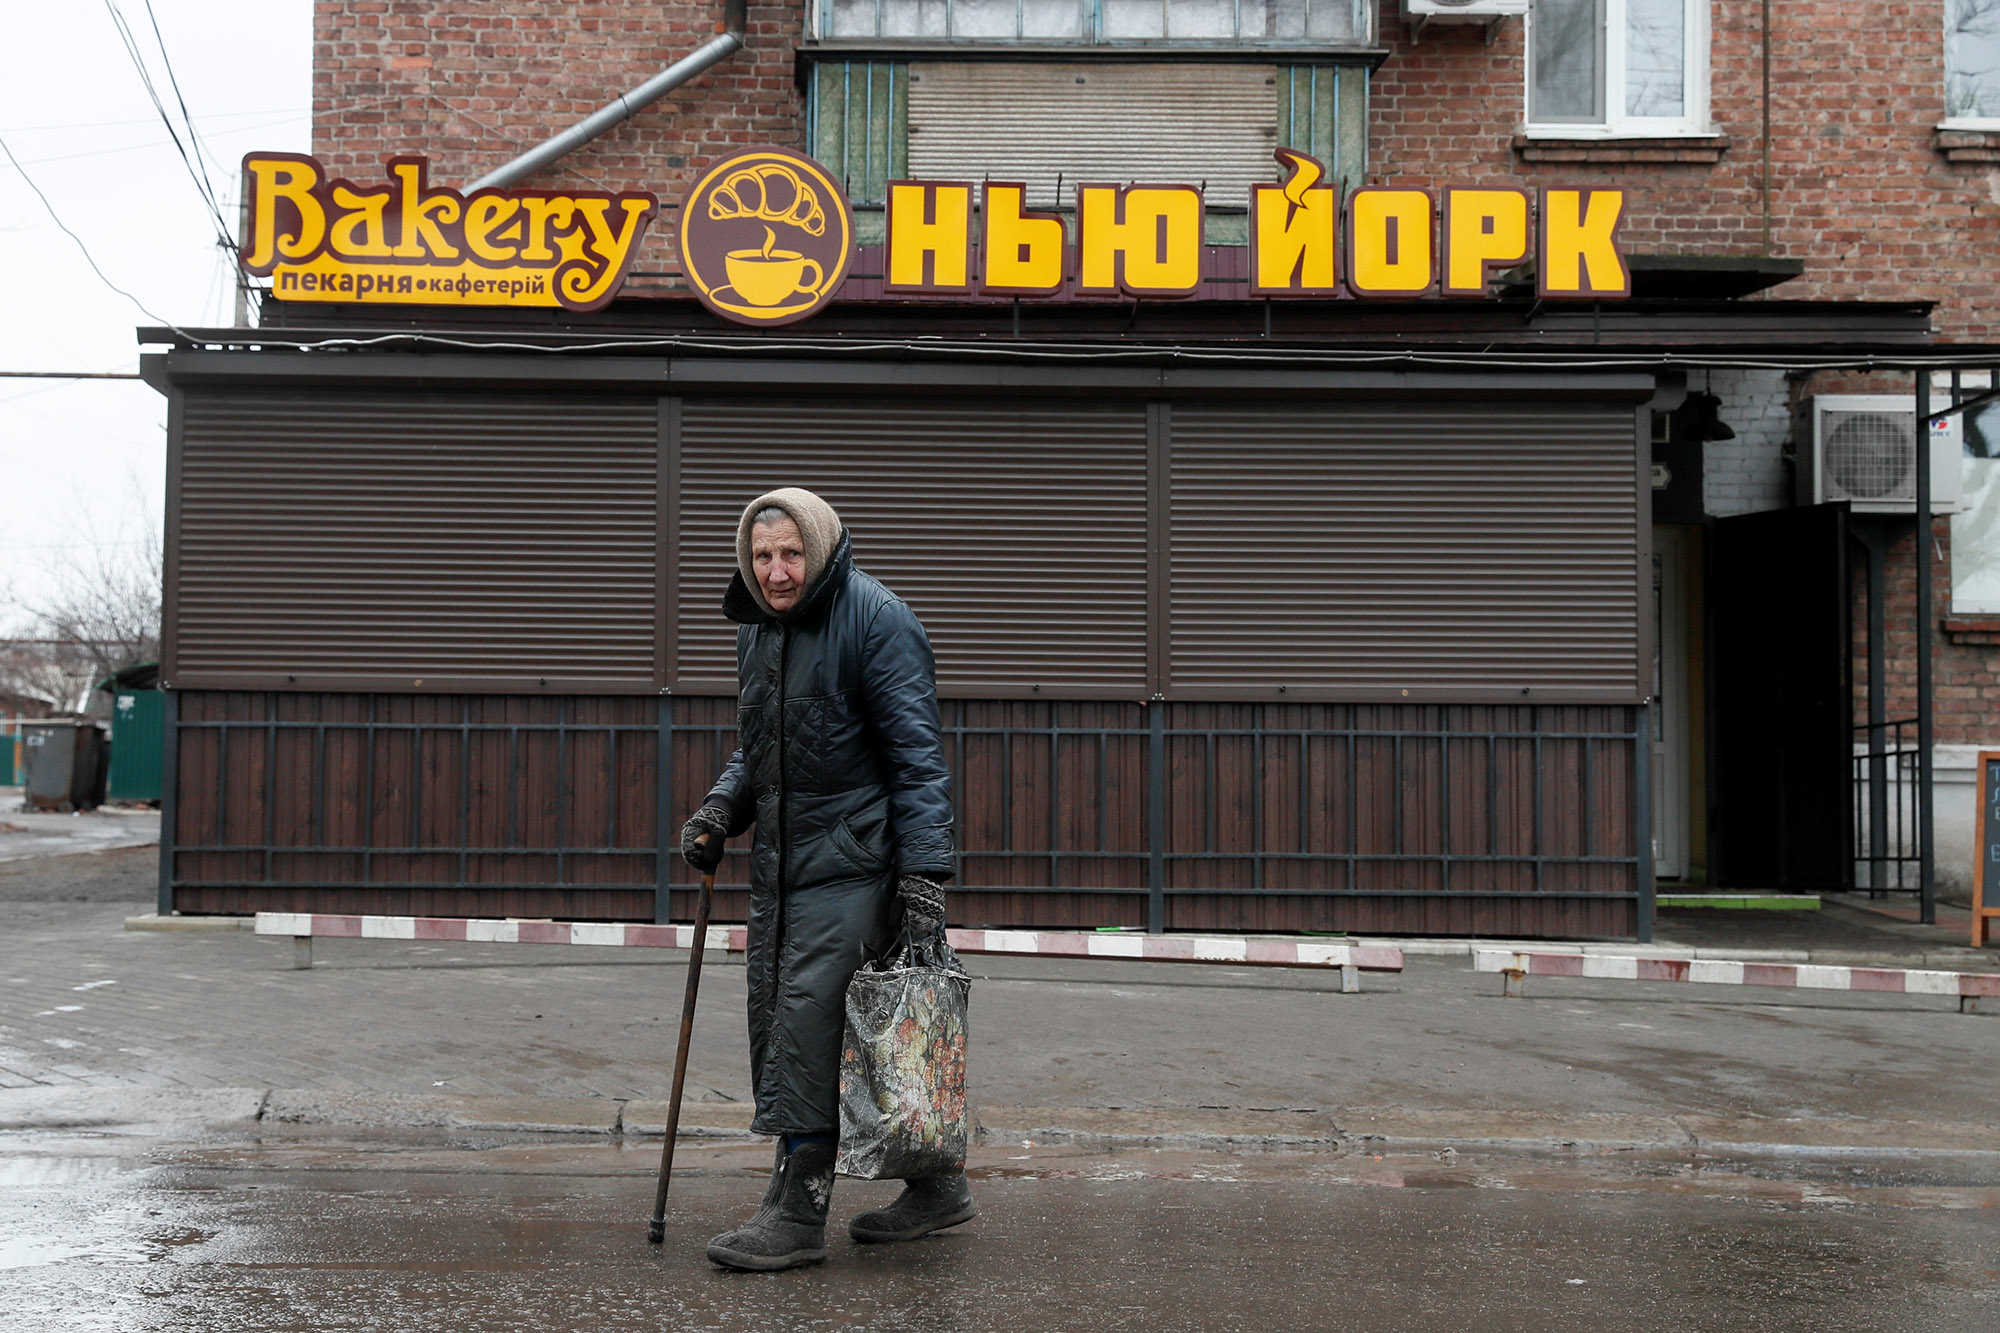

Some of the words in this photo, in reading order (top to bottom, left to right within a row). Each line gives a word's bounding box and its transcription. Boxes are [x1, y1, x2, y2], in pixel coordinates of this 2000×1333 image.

[247, 159, 651, 304] Bakery
[281, 271, 412, 299] пекарня
[429, 273, 545, 299] кафетерій
[889, 184, 1200, 290] НЬЮ
[1256, 153, 1626, 291] ЙОРК
